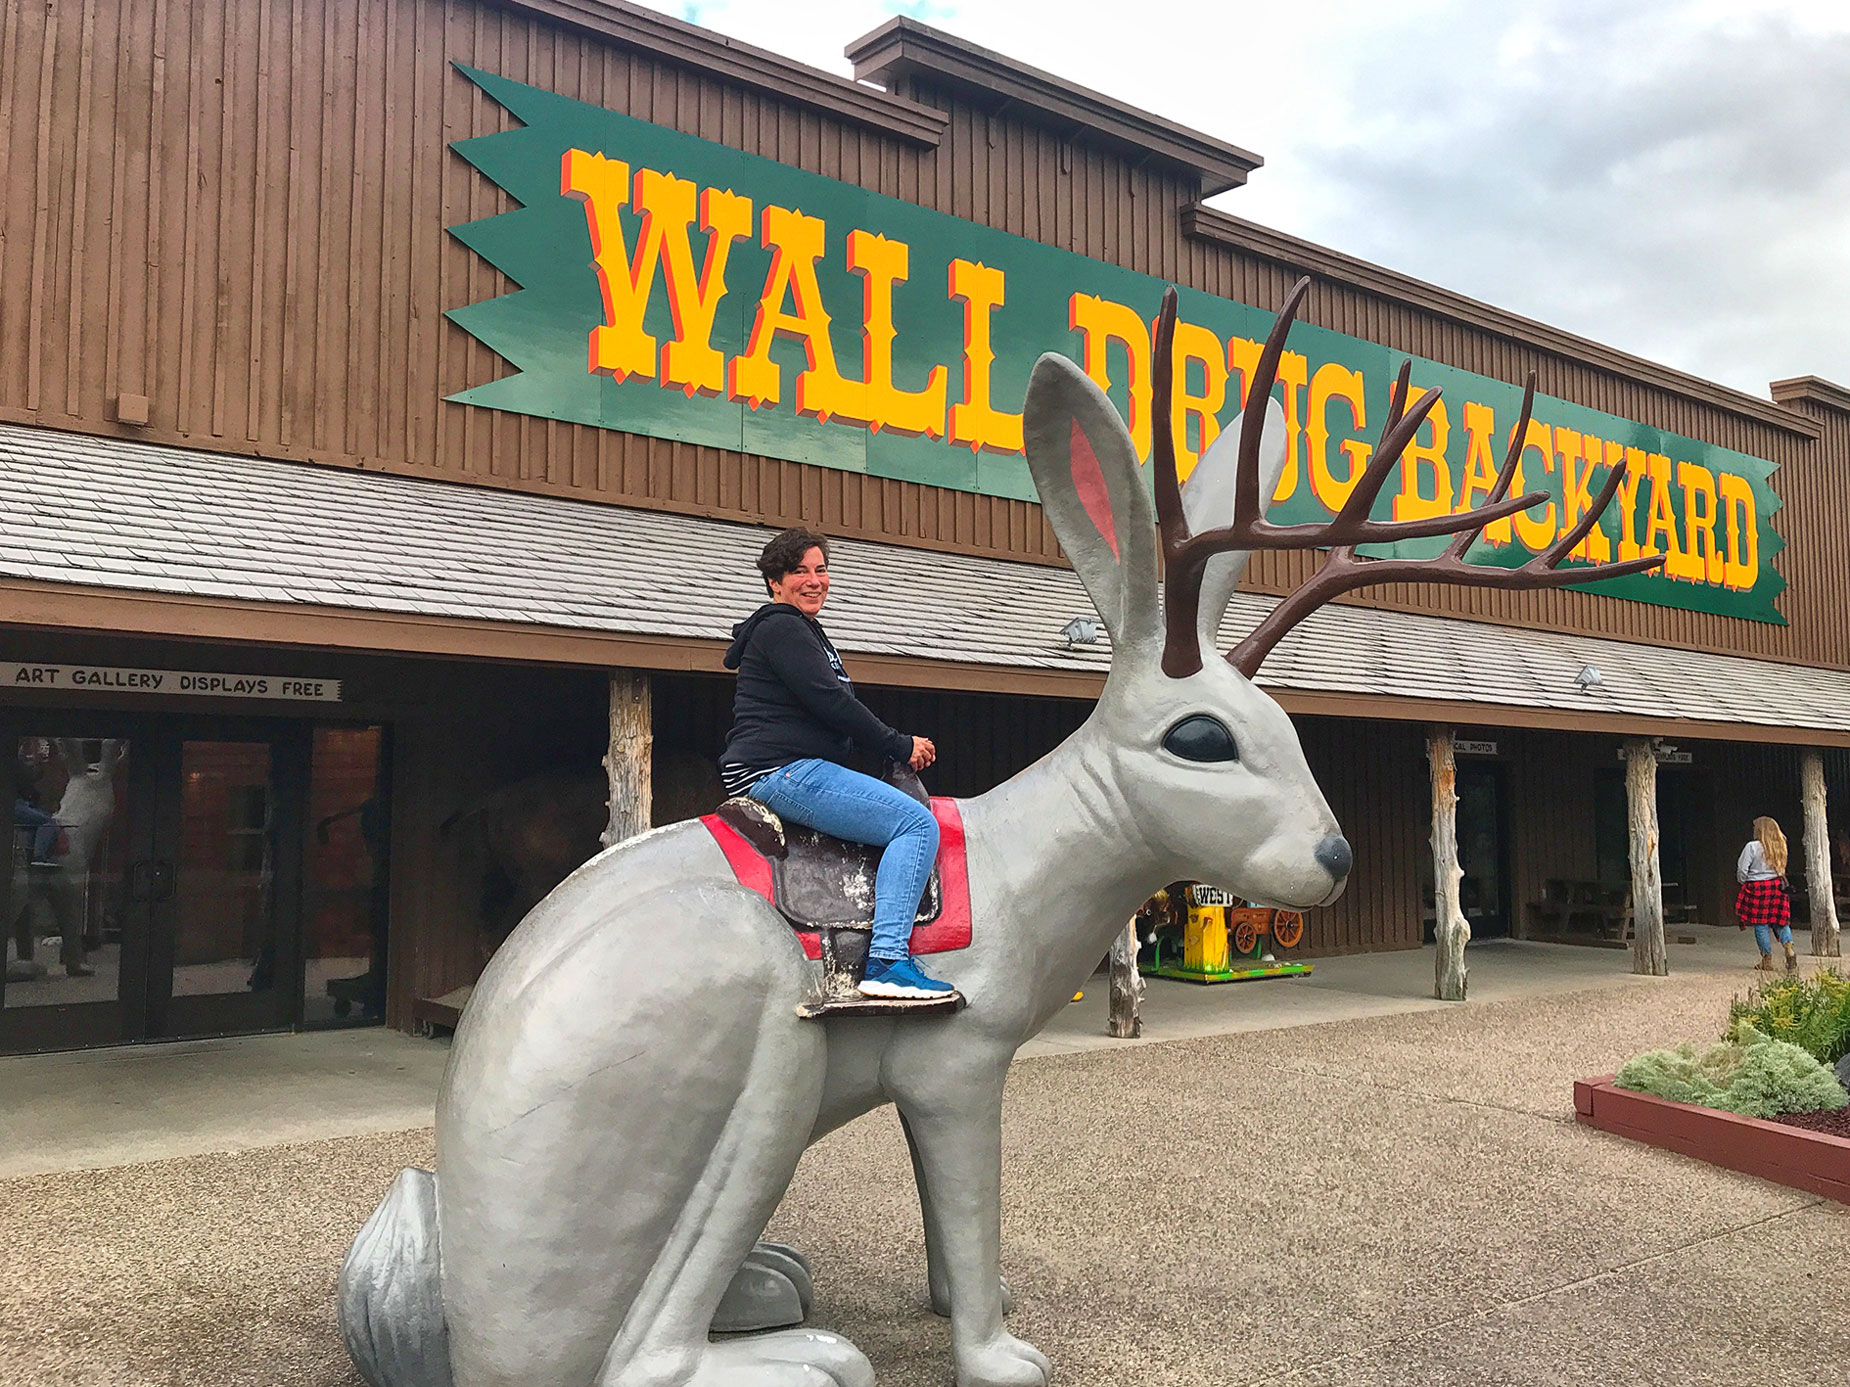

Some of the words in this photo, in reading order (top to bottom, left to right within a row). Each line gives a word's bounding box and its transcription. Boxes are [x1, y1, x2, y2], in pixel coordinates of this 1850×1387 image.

[561, 148, 1025, 456] WALL
[1069, 292, 1373, 517] DRUG
[1390, 381, 1760, 593] BACKYARD
[15, 667, 60, 684] ART
[72, 669, 164, 690] GALLERY
[179, 675, 269, 694] DISPLAYS
[282, 681, 324, 697] FREE
[1469, 743, 1493, 753] PHOTOS
